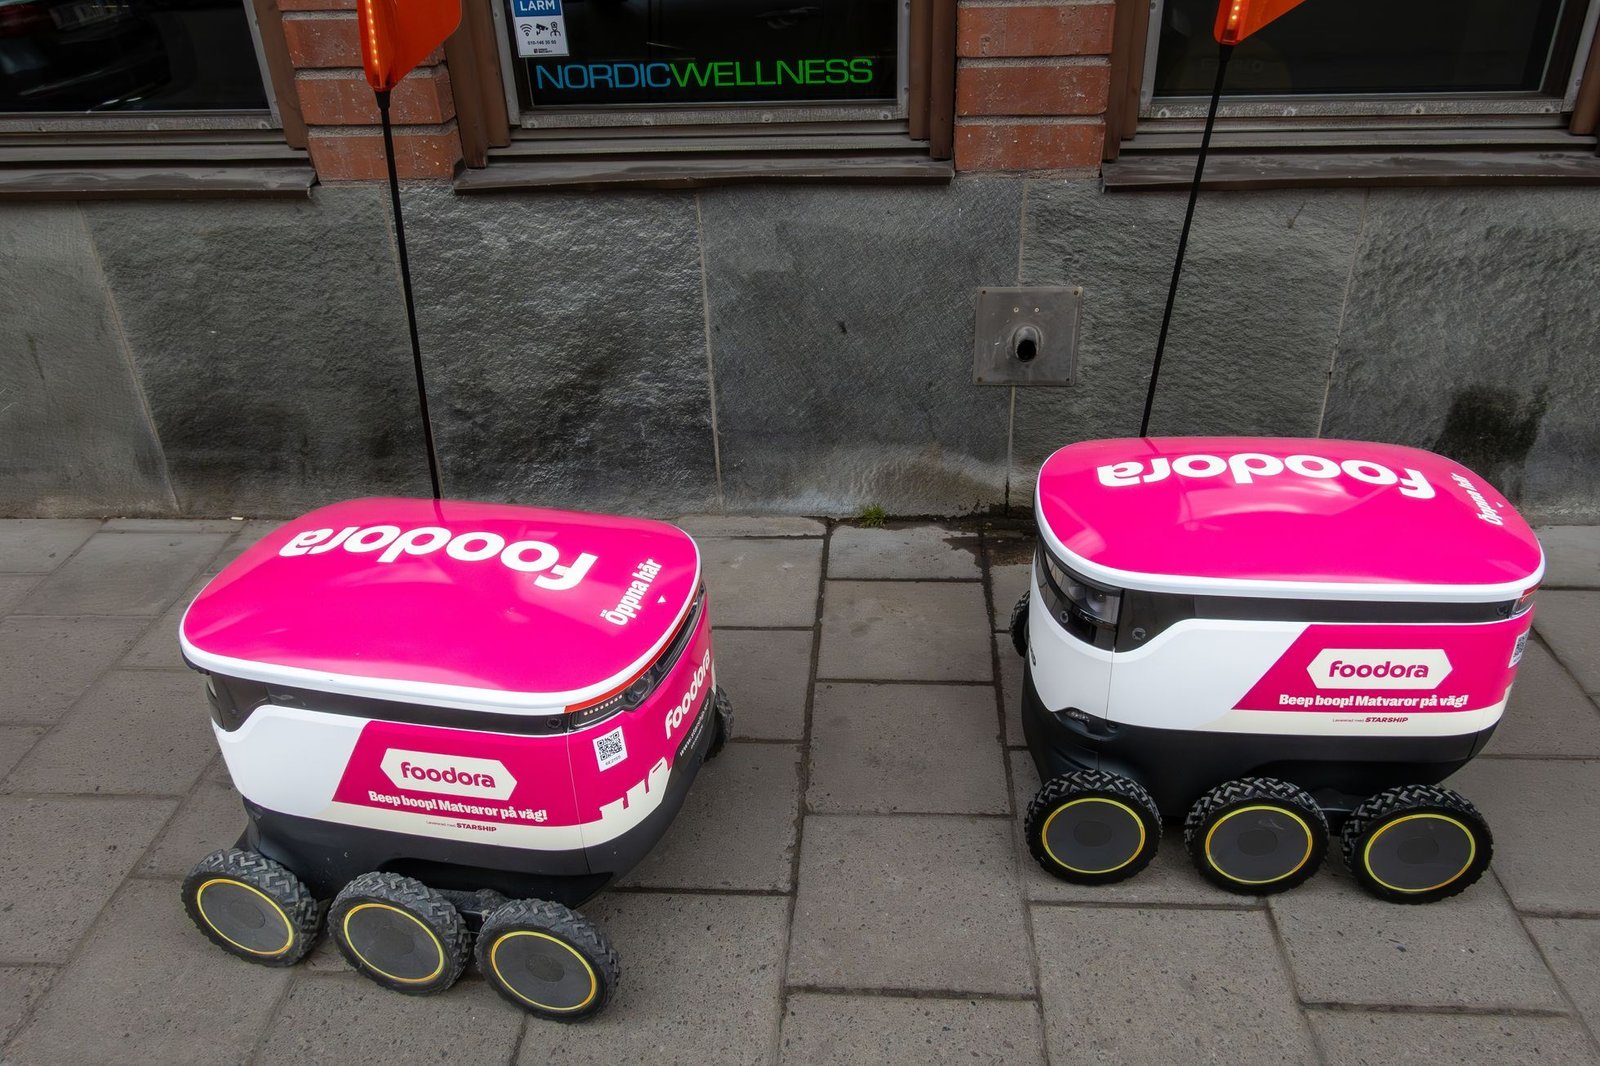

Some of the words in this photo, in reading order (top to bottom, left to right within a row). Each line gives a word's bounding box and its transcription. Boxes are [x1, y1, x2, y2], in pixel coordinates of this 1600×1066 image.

[520, 0, 556, 11] LARM
[1096, 453, 1436, 500] foodora
[278, 525, 599, 591] foodora
[600, 579, 650, 626] Öppna
[631, 558, 663, 583] här
[1328, 660, 1430, 679] foodora
[665, 648, 710, 740] foodora
[1279, 694, 1314, 708] Beep
[1314, 694, 1354, 708] boop!
[1355, 695, 1420, 707] Matvaror
[1419, 695, 1438, 709] på
[1439, 694, 1469, 708] väg!
[400, 761, 497, 789] foodora
[368, 790, 401, 807] Beep
[401, 794, 438, 811] boop!
[438, 799, 499, 817] Matvaror
[500, 806, 517, 820] på
[518, 808, 548, 823] väg!
[456, 822, 497, 832] STARSHIP
